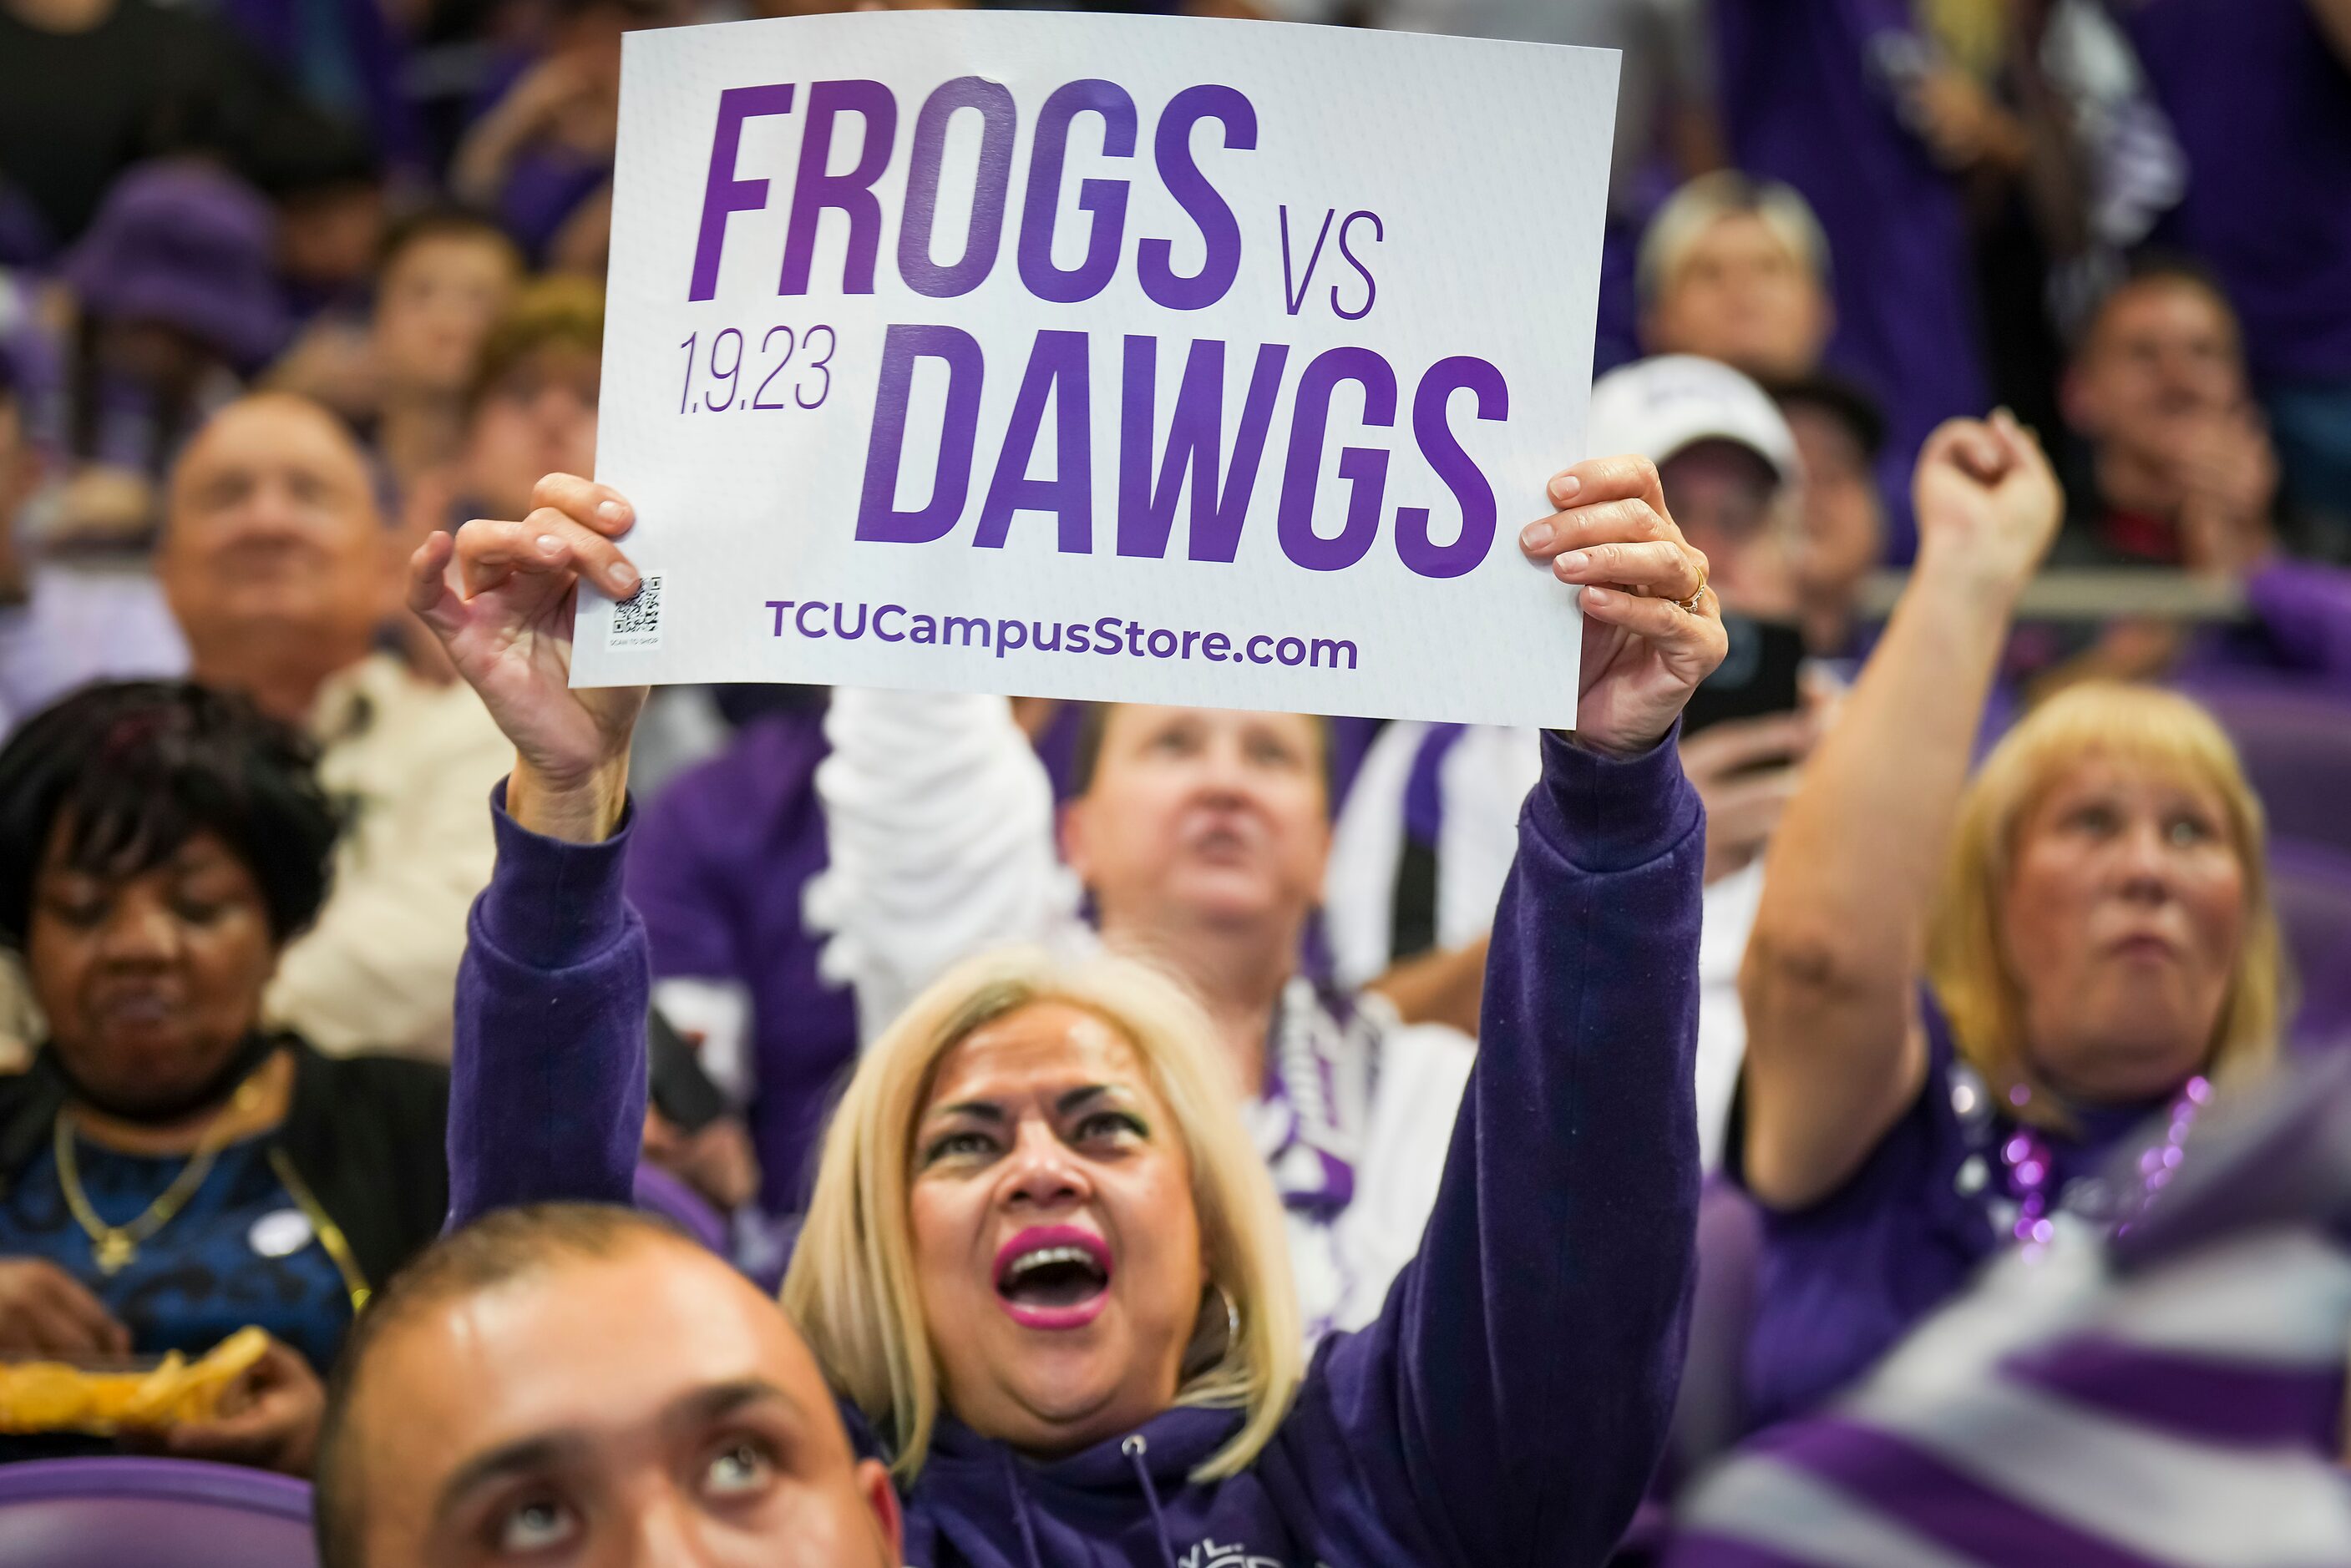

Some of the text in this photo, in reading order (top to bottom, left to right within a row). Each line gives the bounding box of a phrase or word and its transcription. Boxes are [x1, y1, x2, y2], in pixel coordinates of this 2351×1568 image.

[688, 76, 1383, 320] FROGS VS
[681, 324, 835, 414] 1.9.23
[854, 324, 1508, 579] DAWGS
[765, 600, 1358, 670] TCUCampusStore.com
